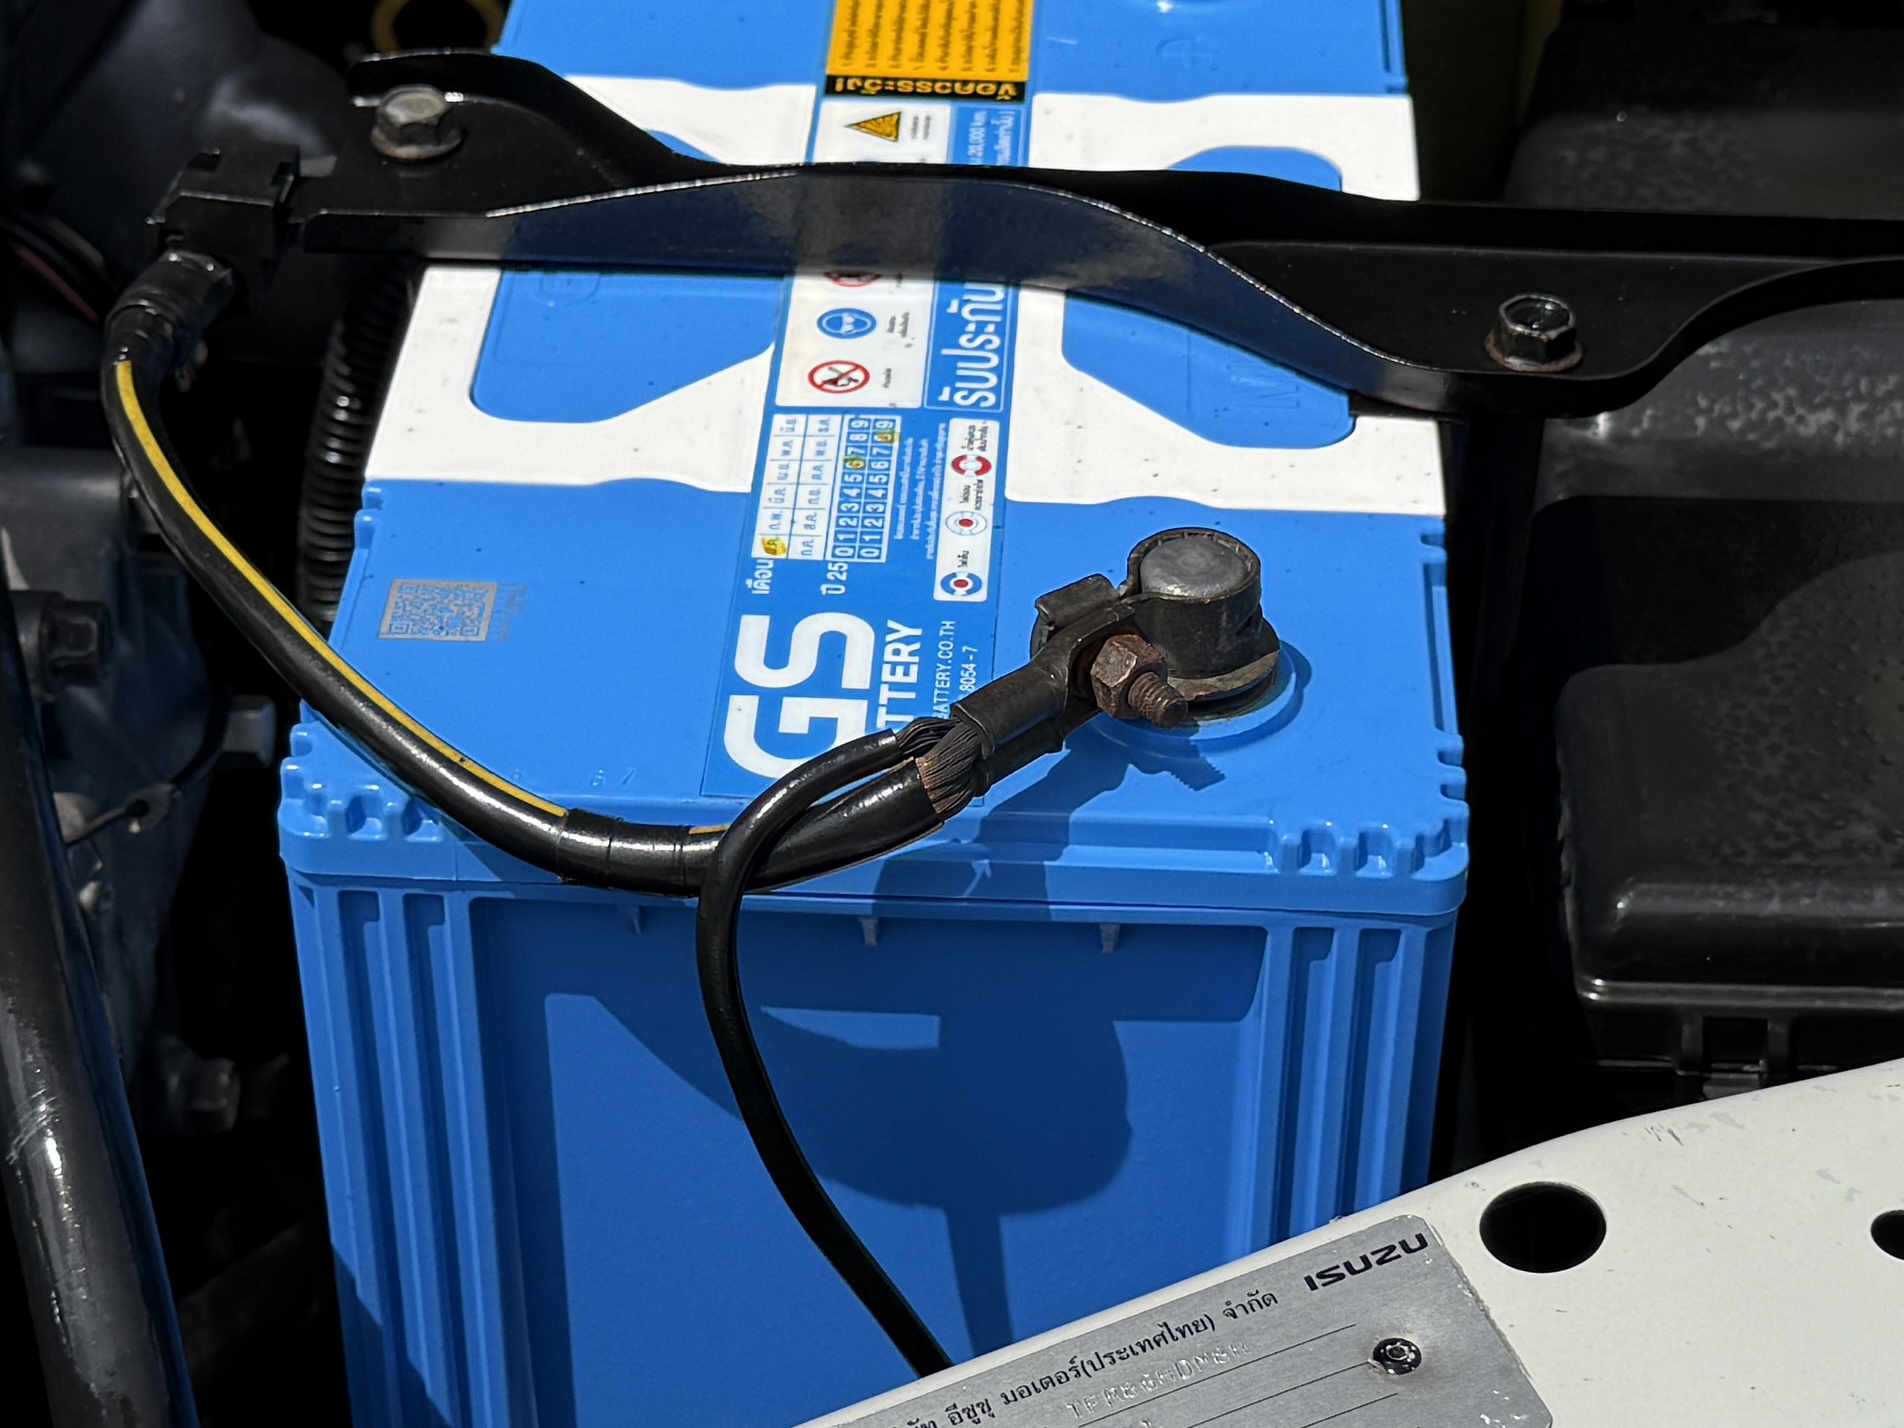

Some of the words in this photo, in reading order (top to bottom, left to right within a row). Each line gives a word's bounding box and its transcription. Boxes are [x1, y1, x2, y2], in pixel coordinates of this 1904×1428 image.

[851, 420, 868, 428] 9
[876, 420, 894, 428] 9
[849, 434, 866, 442] 8
[848, 447, 865, 455] 7
[846, 459, 865, 469] 6
[871, 461, 889, 469] 6
[844, 474, 862, 483] 5
[869, 475, 887, 483] 5
[842, 488, 860, 497] 4
[867, 489, 886, 498] 4
[840, 503, 859, 512] 3
[865, 504, 883, 513] 3
[839, 517, 857, 527] 2
[864, 518, 882, 527] 2
[834, 548, 855, 557] 0
[860, 548, 879, 557] 0
[827, 563, 848, 581] 25
[746, 559, 775, 595] เดือน
[821, 585, 846, 595] ปี
[876, 619, 923, 732] TTERY
[723, 612, 876, 778] GS
[1303, 1233, 1431, 1293] ISUZU
[999, 1313, 1216, 1407] มอเตอร์(ประเทศไทย)
[1221, 1287, 1279, 1327] จำกัด
